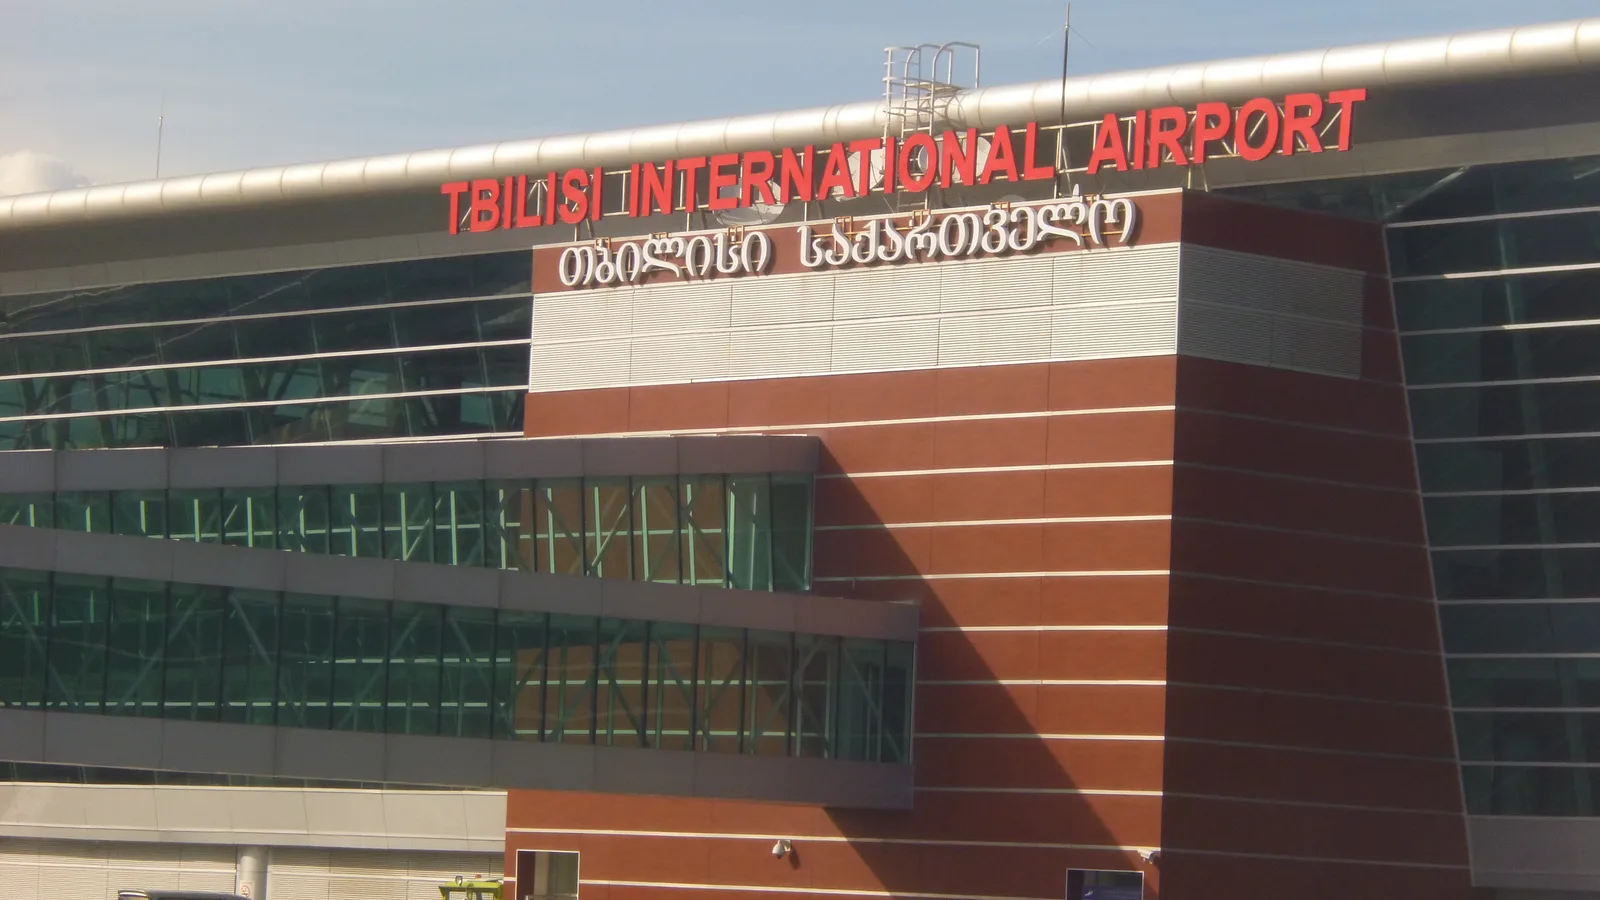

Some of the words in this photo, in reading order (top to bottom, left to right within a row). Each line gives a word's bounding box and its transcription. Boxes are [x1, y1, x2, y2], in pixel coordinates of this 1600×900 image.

[440, 166, 603, 235] TBILISI
[628, 121, 1055, 218] INTERNATIONAL
[1087, 88, 1366, 175] AIRPORT
[558, 230, 771, 287] თბილისი
[797, 194, 1136, 268] საქართველო
